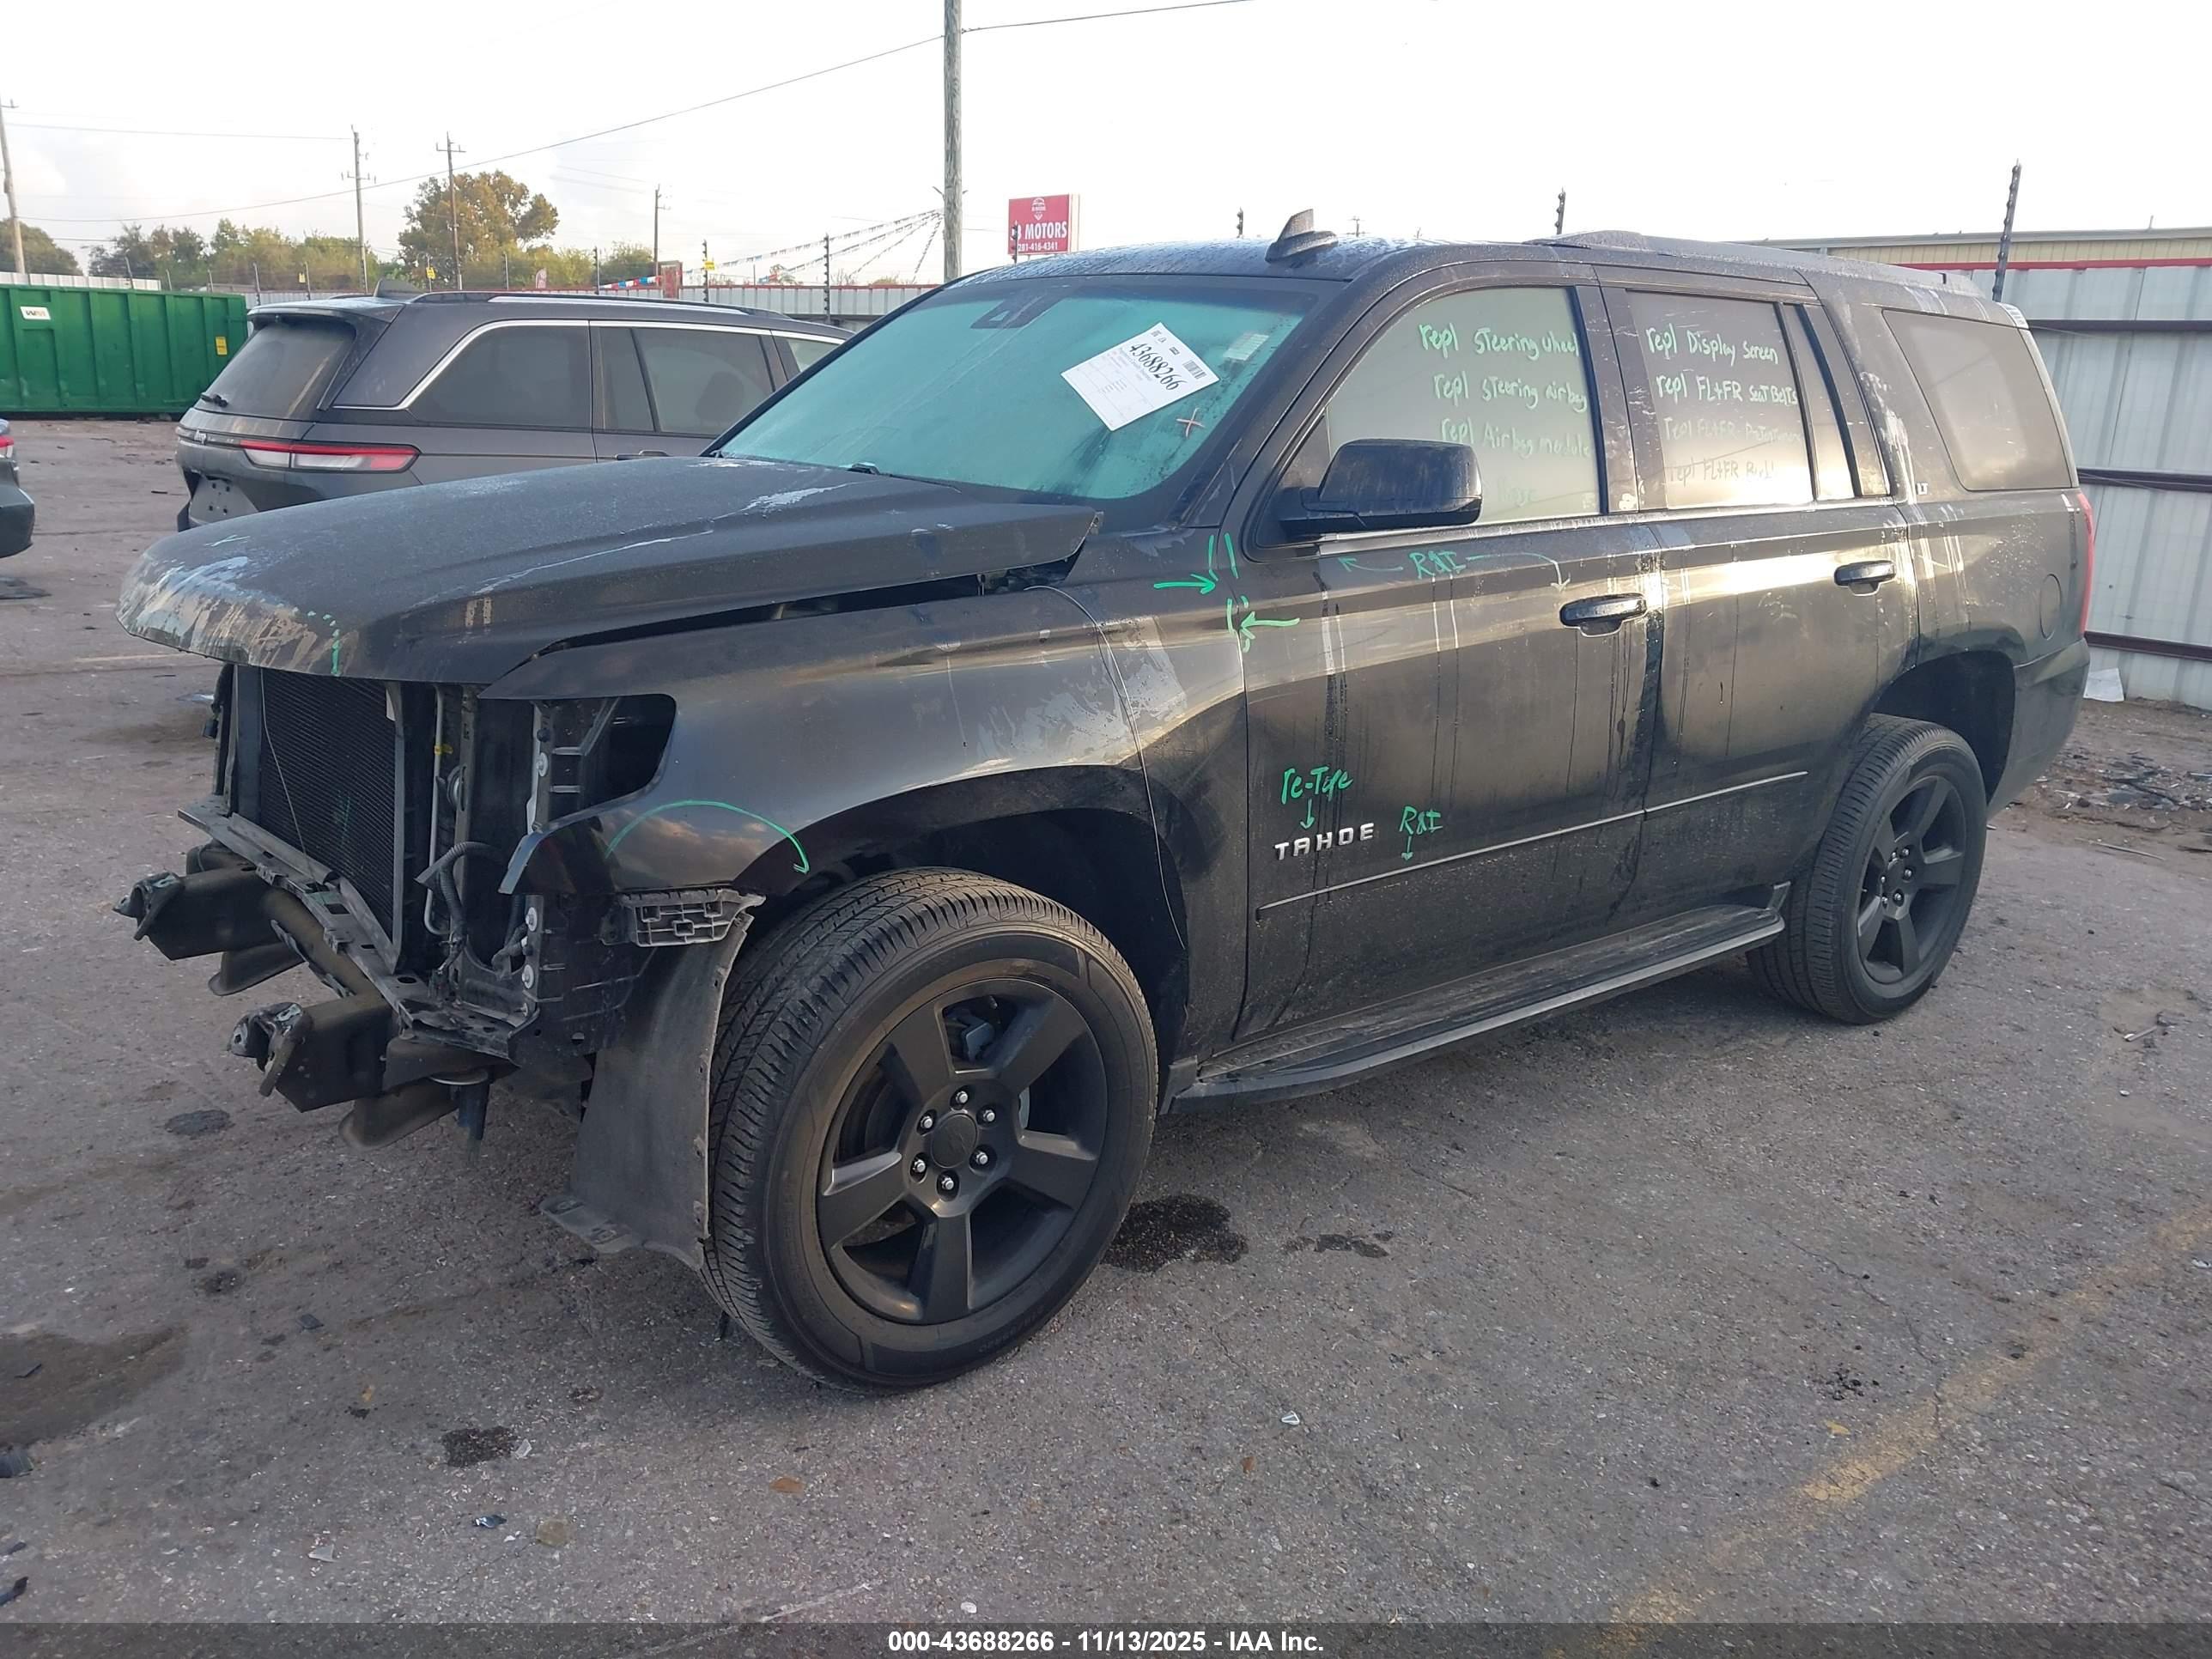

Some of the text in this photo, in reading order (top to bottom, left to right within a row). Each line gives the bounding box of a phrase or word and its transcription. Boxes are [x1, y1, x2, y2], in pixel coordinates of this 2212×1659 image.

[1024, 221, 1067, 240] MOTORS
[1129, 343, 1188, 391] 43688266
[1686, 330, 1736, 367] Display
[1274, 823, 1375, 860] TAHOE
